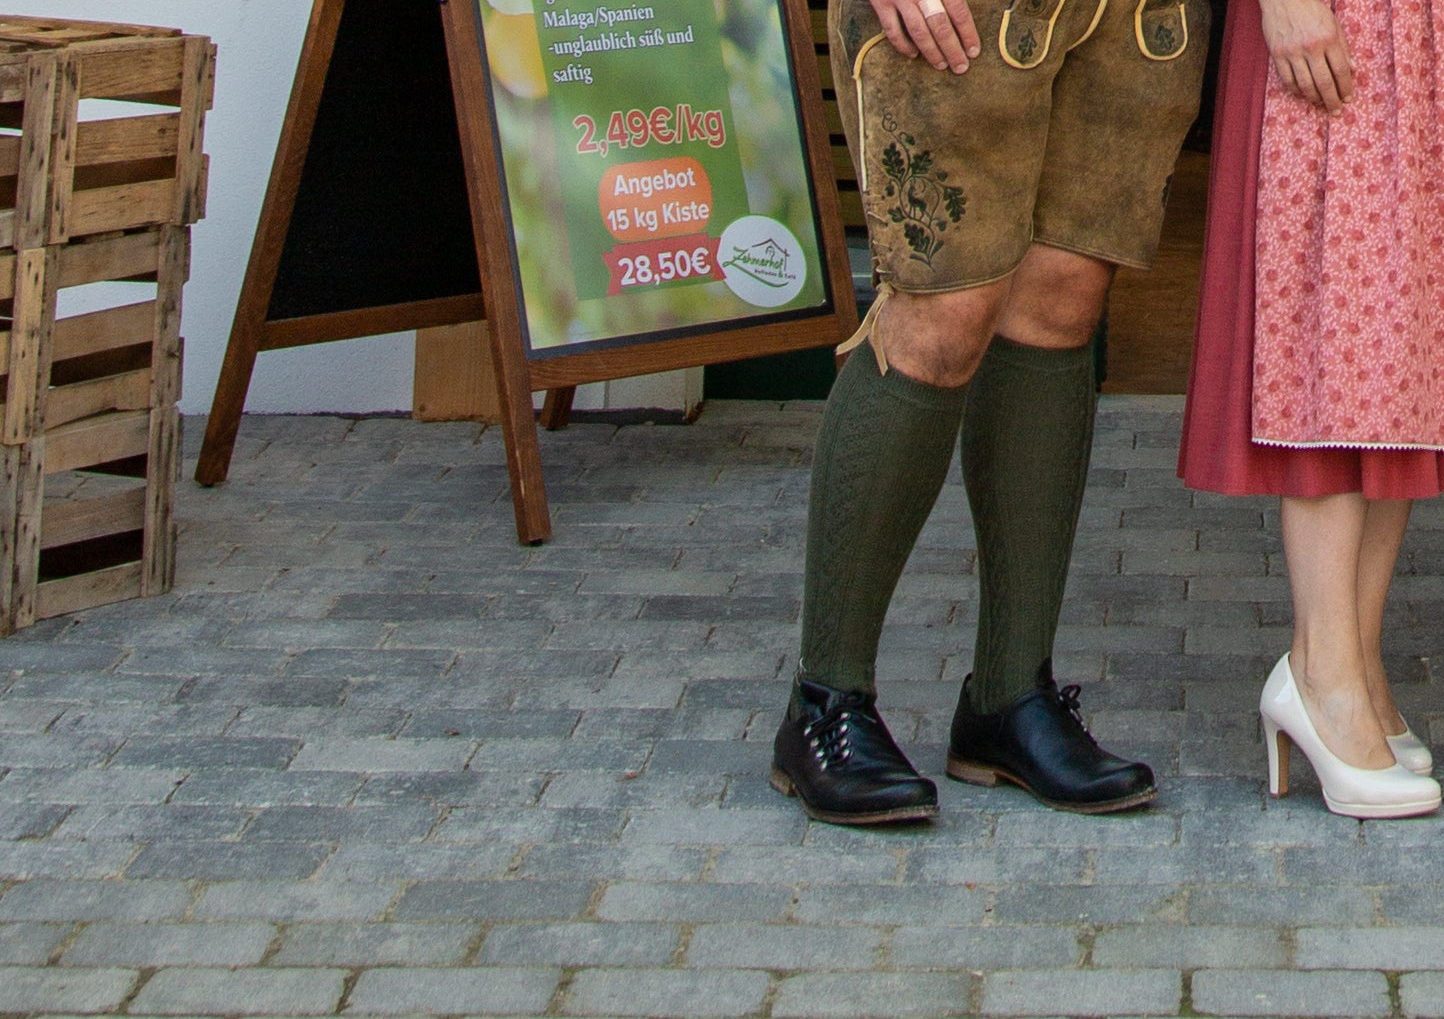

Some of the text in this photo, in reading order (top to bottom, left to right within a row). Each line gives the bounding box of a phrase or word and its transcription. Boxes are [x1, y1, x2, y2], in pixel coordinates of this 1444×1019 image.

[543, 5, 654, 29] Malaga/Spanien
[548, 26, 694, 58] -unglaublich süß und
[553, 65, 593, 84] saftig
[572, 104, 725, 157] 2,49€/kg
[614, 168, 696, 199] Angebot
[606, 200, 710, 232] 15 kg Kiste
[617, 247, 712, 287] 28,50€
